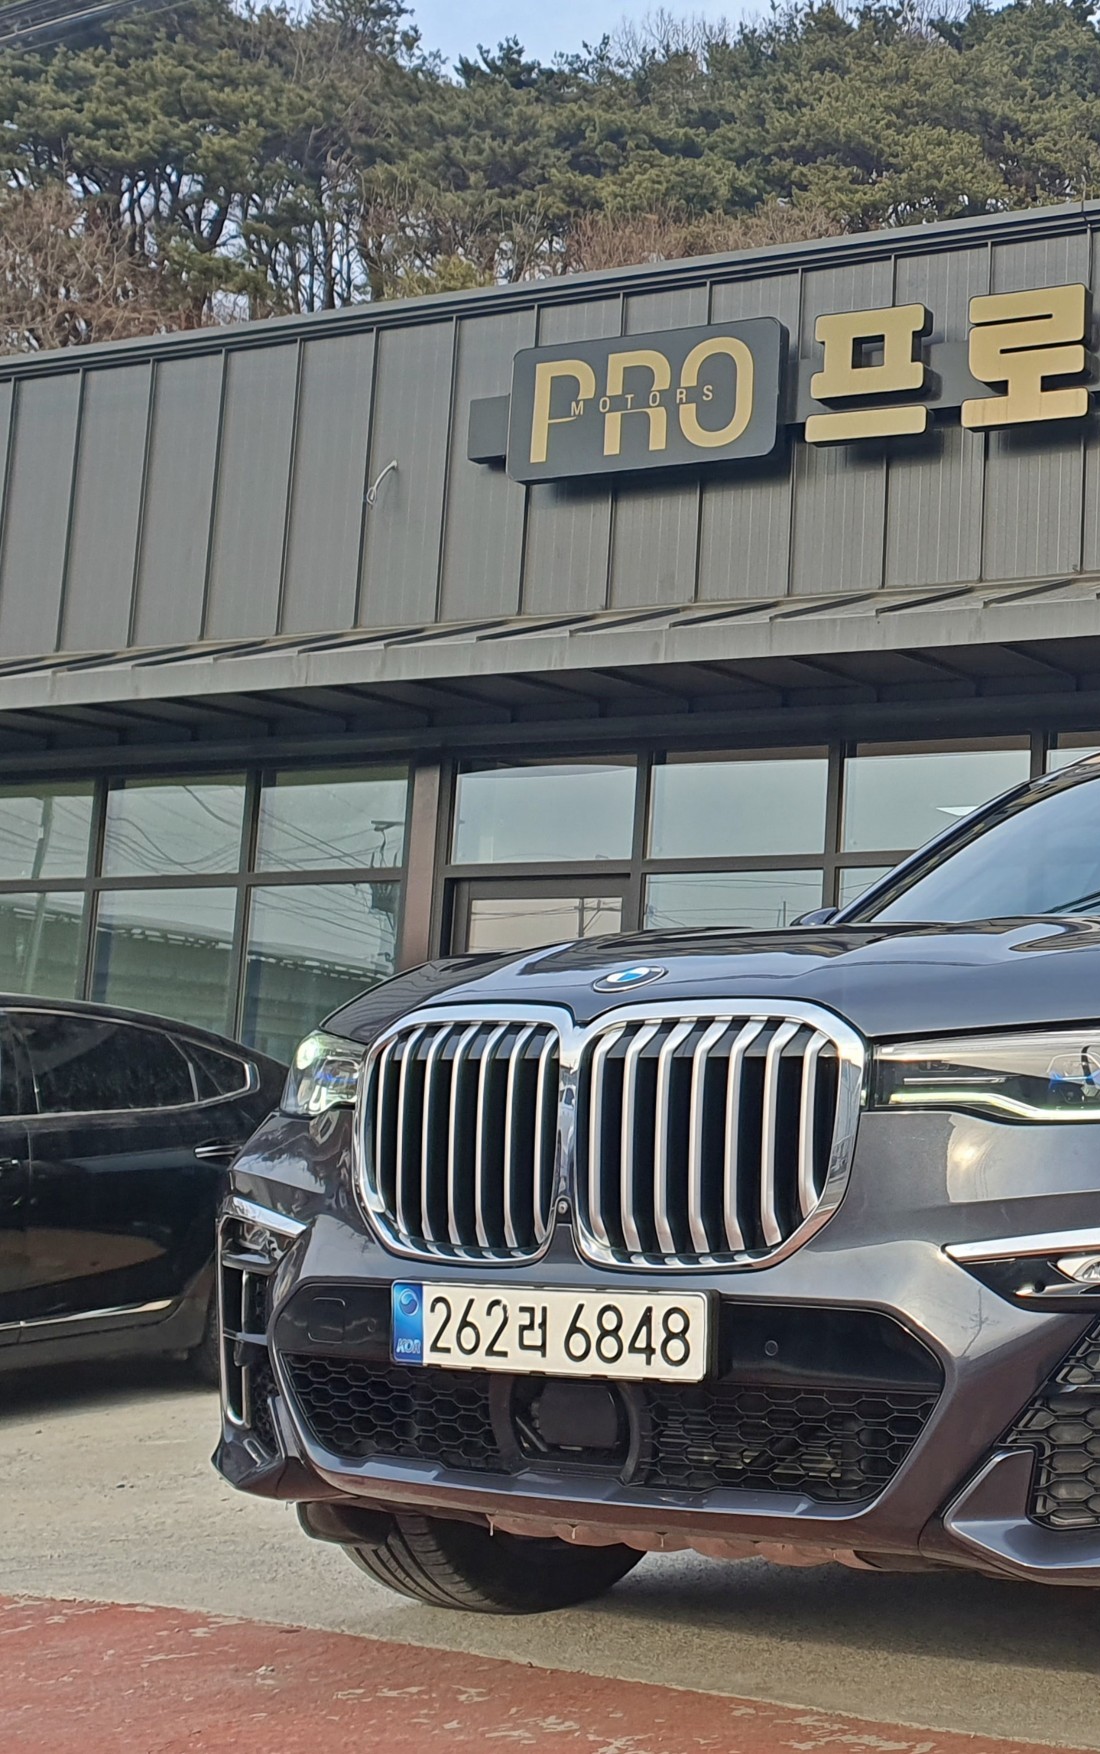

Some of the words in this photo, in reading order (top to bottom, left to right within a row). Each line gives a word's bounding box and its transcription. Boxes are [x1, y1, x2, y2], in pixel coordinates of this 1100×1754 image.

[529, 336, 754, 464] PRO
[570, 384, 713, 417] MOTORS
[429, 1296, 548, 1358] 262러
[564, 1303, 691, 1367] 6848
